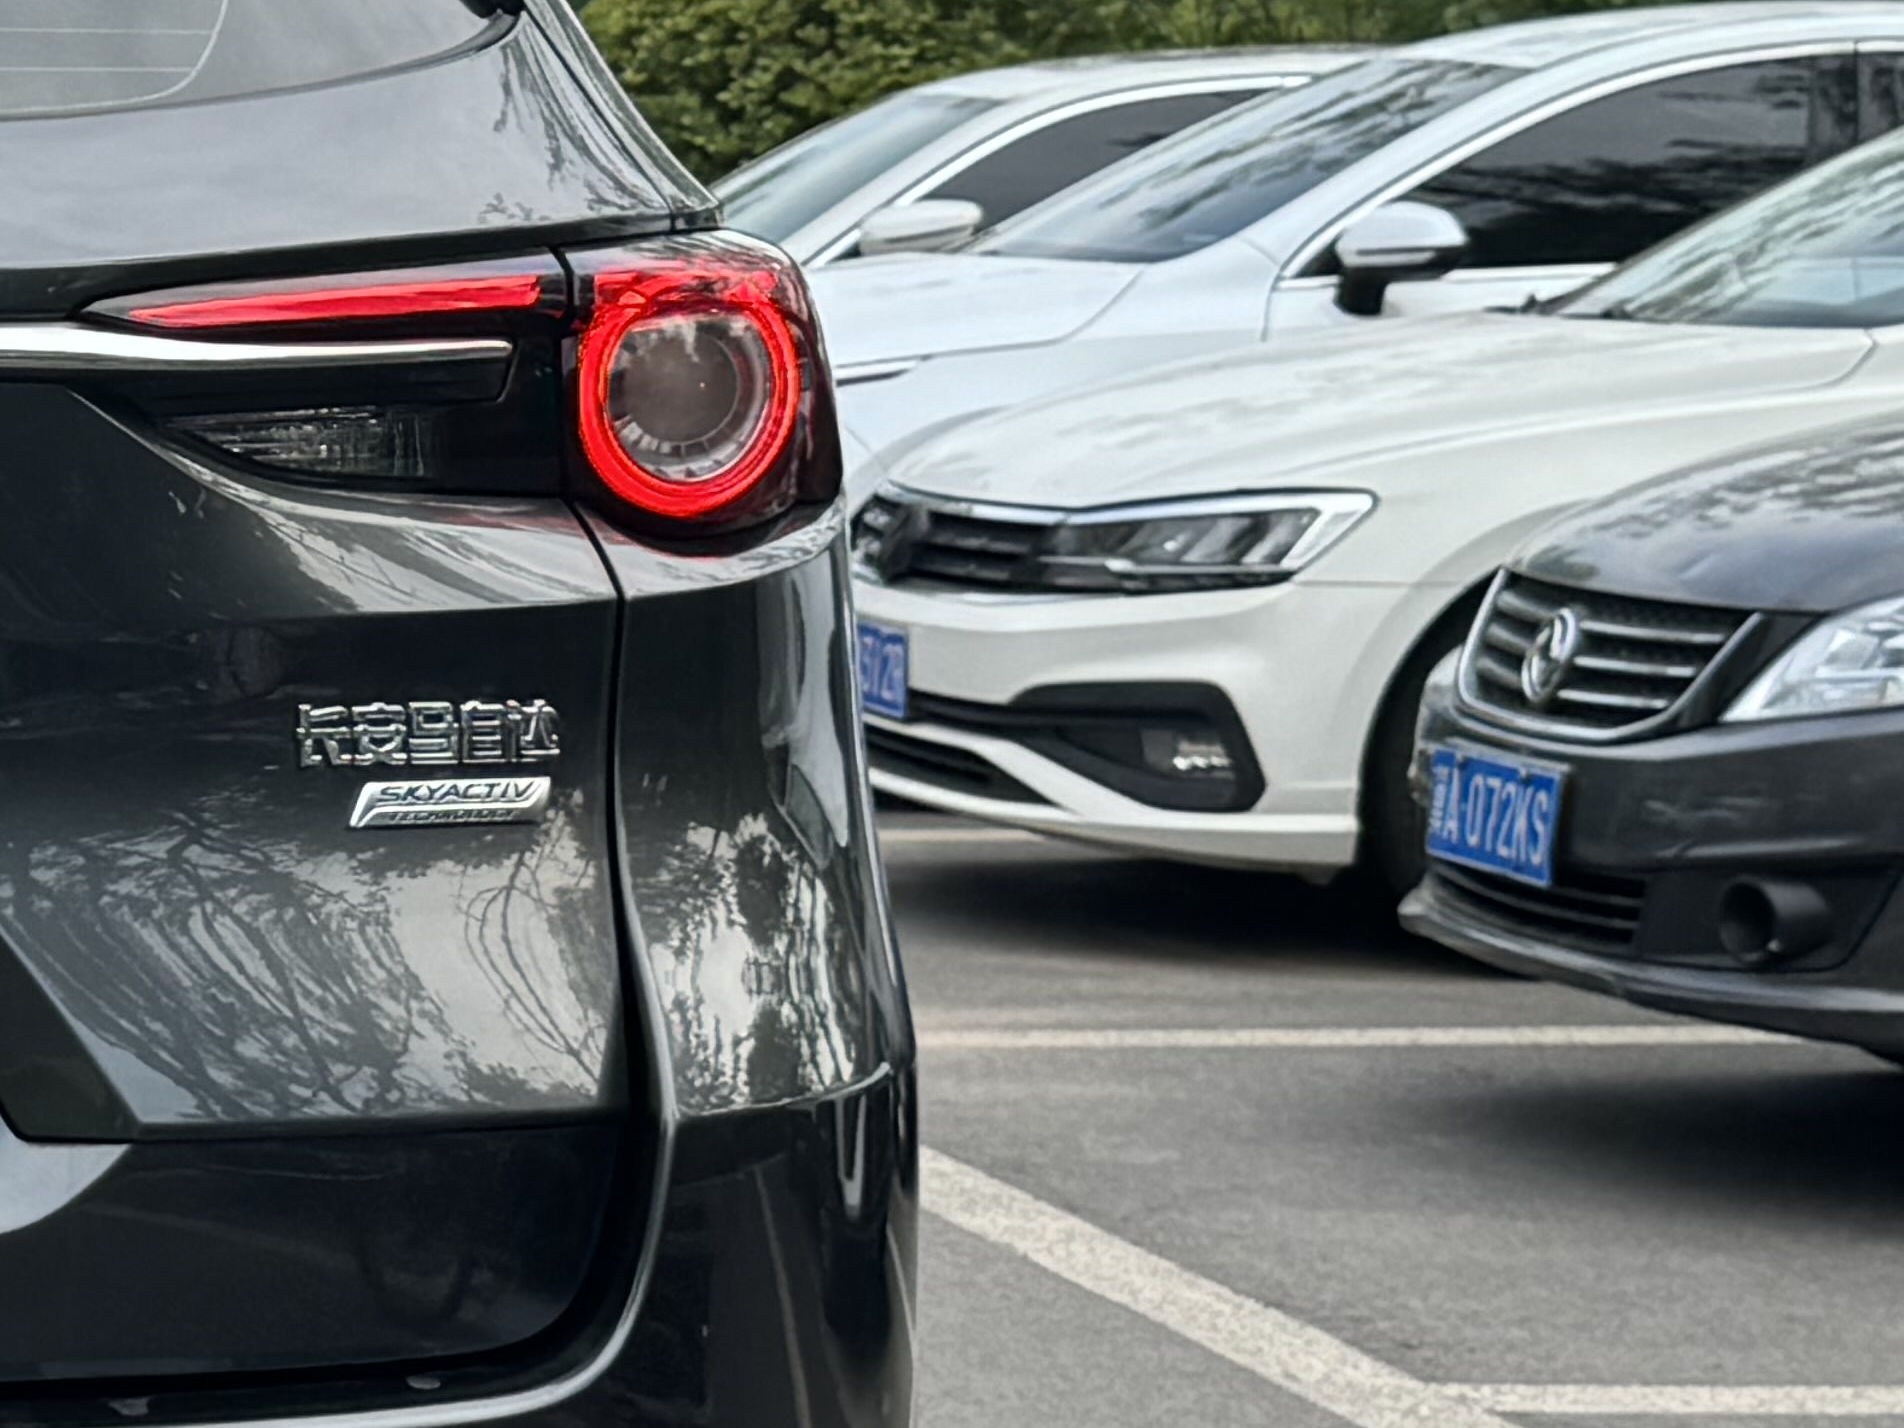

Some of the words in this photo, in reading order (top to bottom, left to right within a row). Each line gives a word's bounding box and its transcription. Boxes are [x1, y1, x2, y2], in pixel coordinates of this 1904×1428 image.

[296, 698, 561, 767] 长安马自达
[378, 780, 535, 803] SKYACTIV
